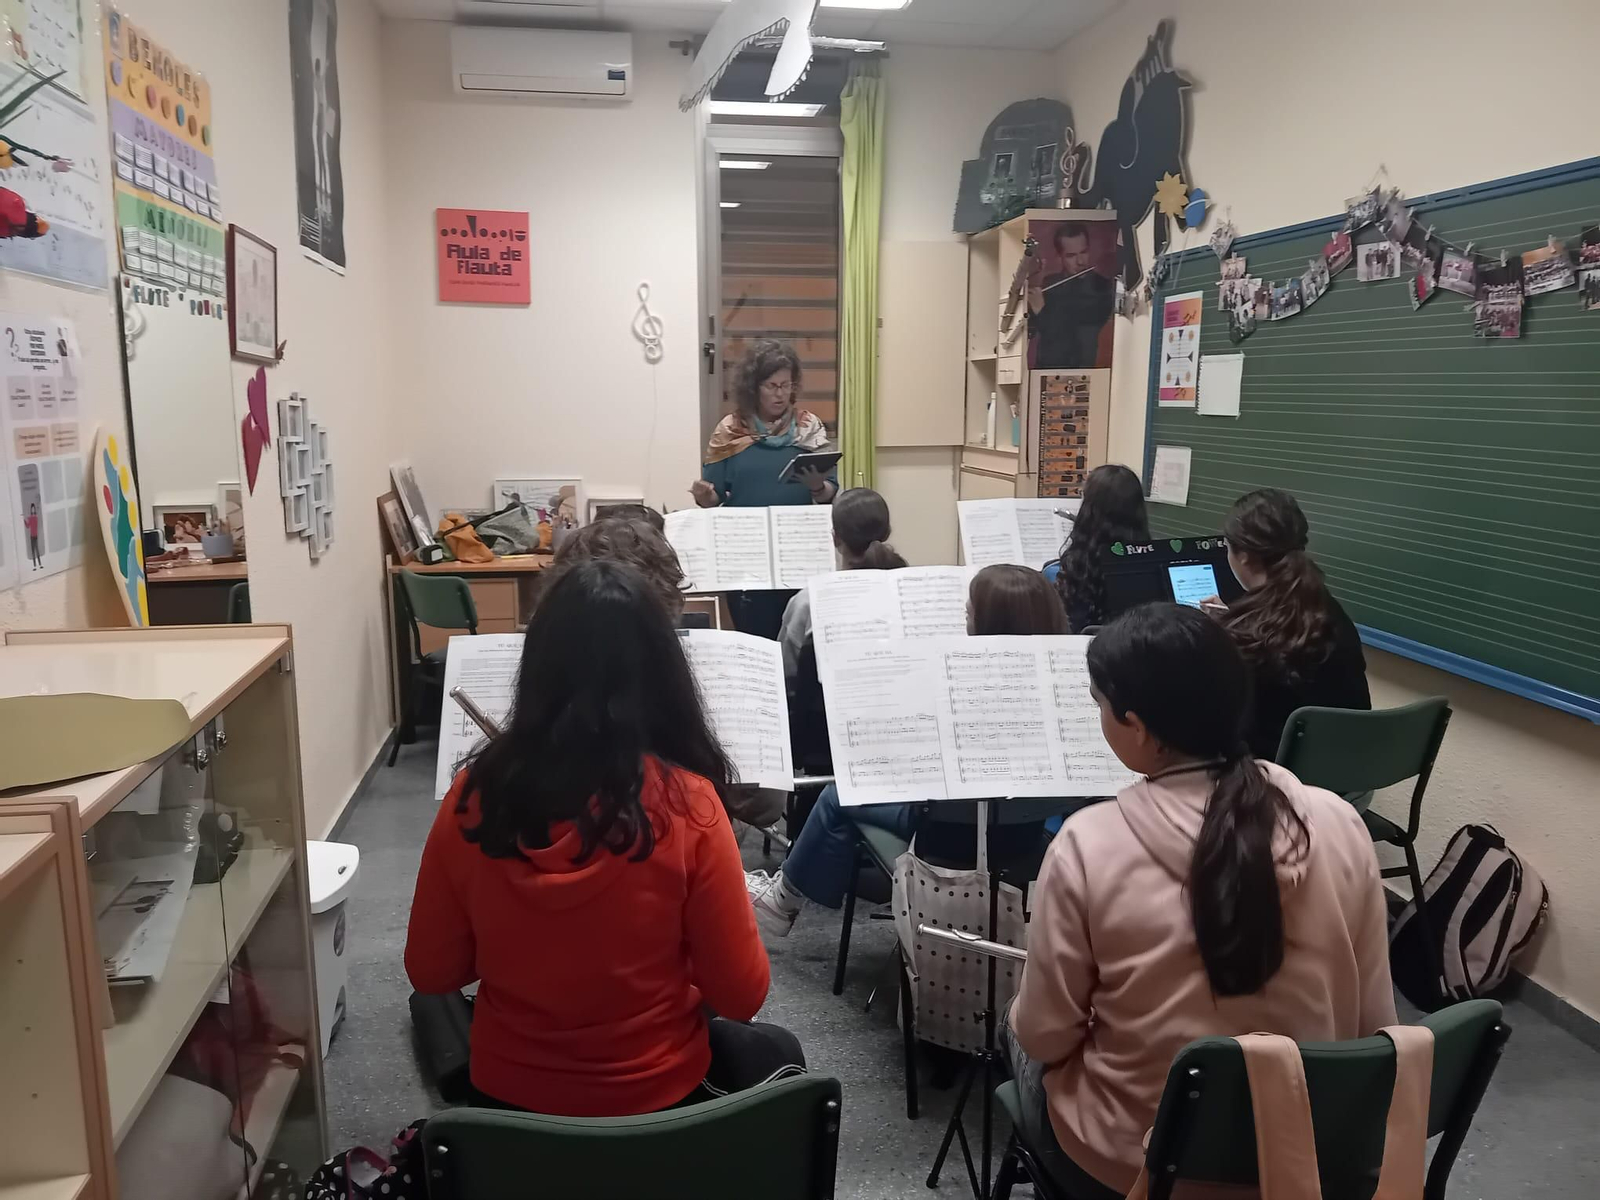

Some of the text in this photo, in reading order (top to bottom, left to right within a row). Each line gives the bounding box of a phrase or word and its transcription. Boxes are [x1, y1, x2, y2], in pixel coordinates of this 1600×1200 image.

[126, 27, 200, 108] BEMOLES
[447, 244, 522, 261] Aula de
[457, 260, 512, 276] Flauta
[133, 284, 170, 307] FLUTE
